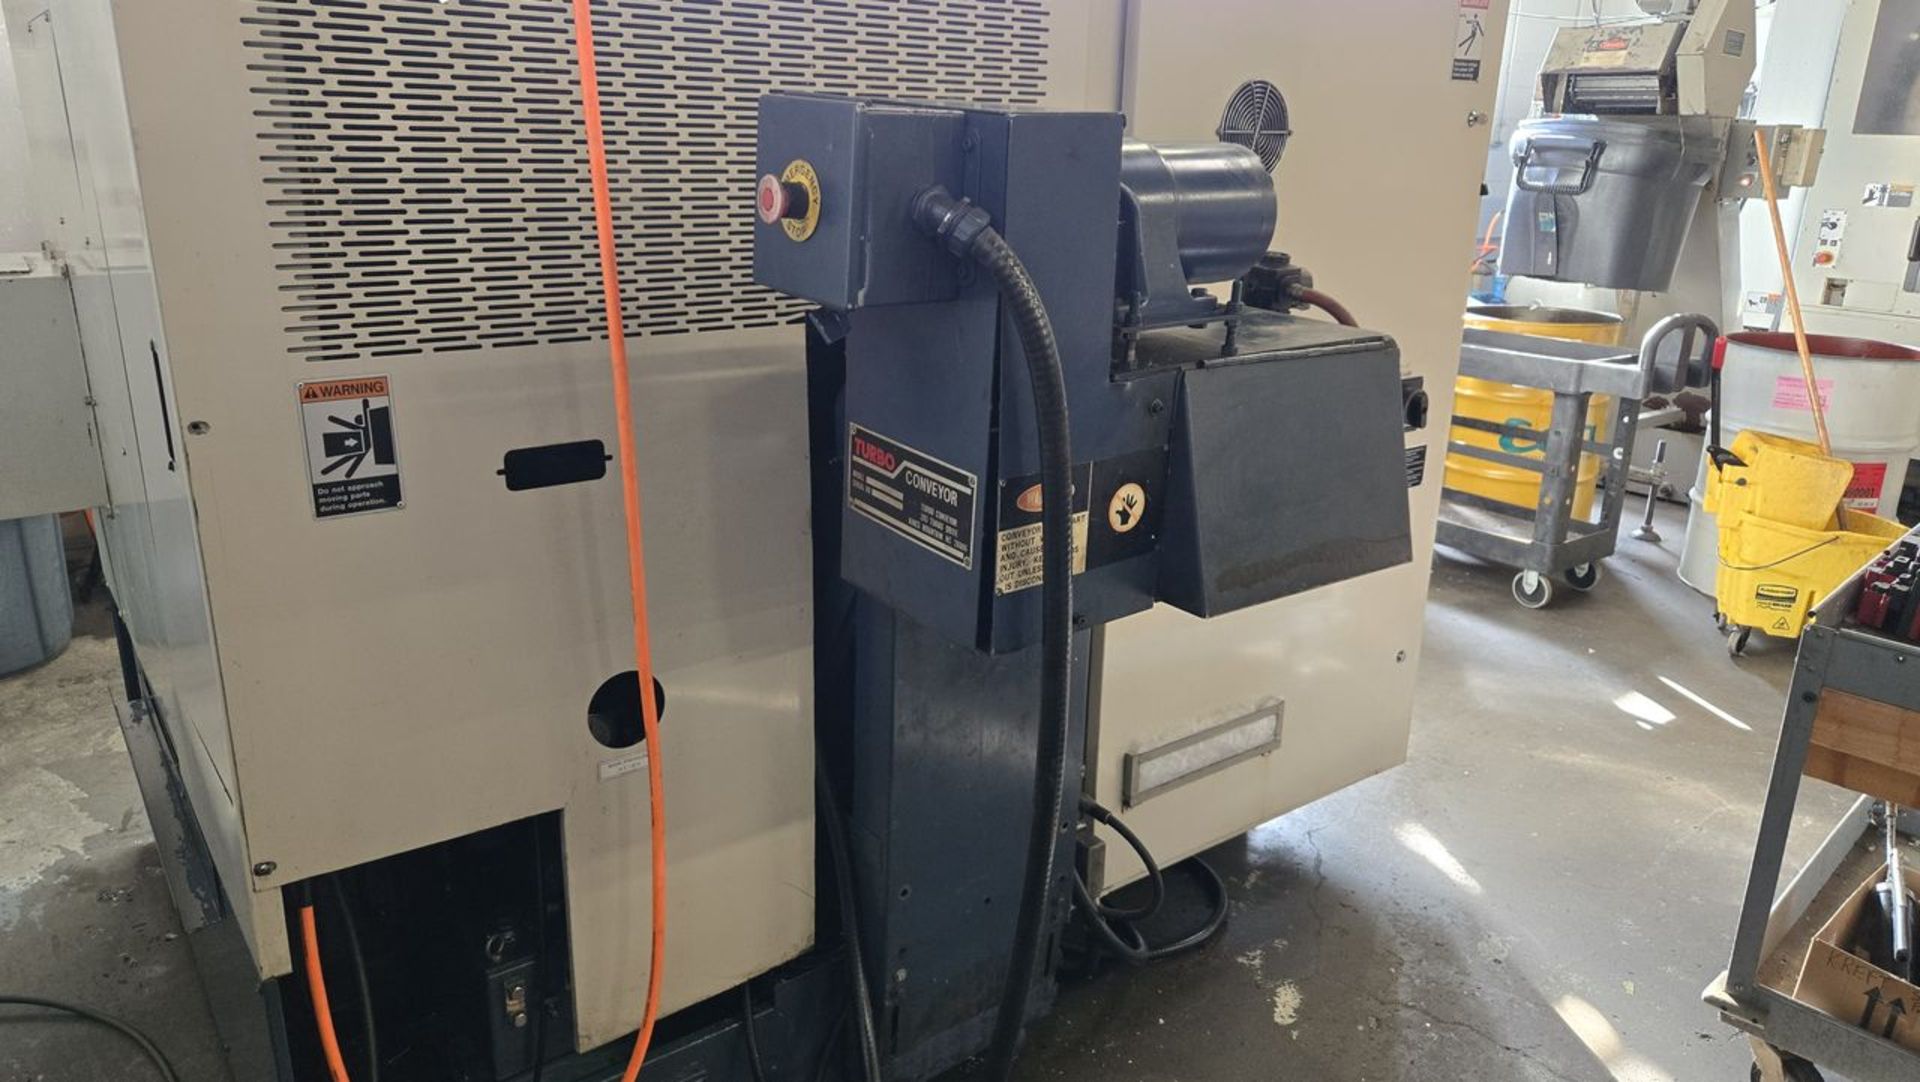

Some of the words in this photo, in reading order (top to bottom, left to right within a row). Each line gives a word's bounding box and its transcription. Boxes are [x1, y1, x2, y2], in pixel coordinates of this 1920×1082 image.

[320, 381, 384, 398] WARNING
[854, 437, 895, 471] TURBO
[317, 487, 330, 495] Do
[331, 485, 345, 493] not
[347, 481, 384, 492] approach
[905, 471, 958, 507] CONVEYOR
[318, 493, 348, 504] moving
[350, 491, 371, 501] parts
[319, 502, 346, 513] during
[1001, 525, 1042, 542] CONVEYOR
[1001, 537, 1036, 552] WITHOUT
[1000, 552, 1016, 562] AND
[1017, 565, 1042, 578] UNLES
[1005, 581, 1012, 591] IS
